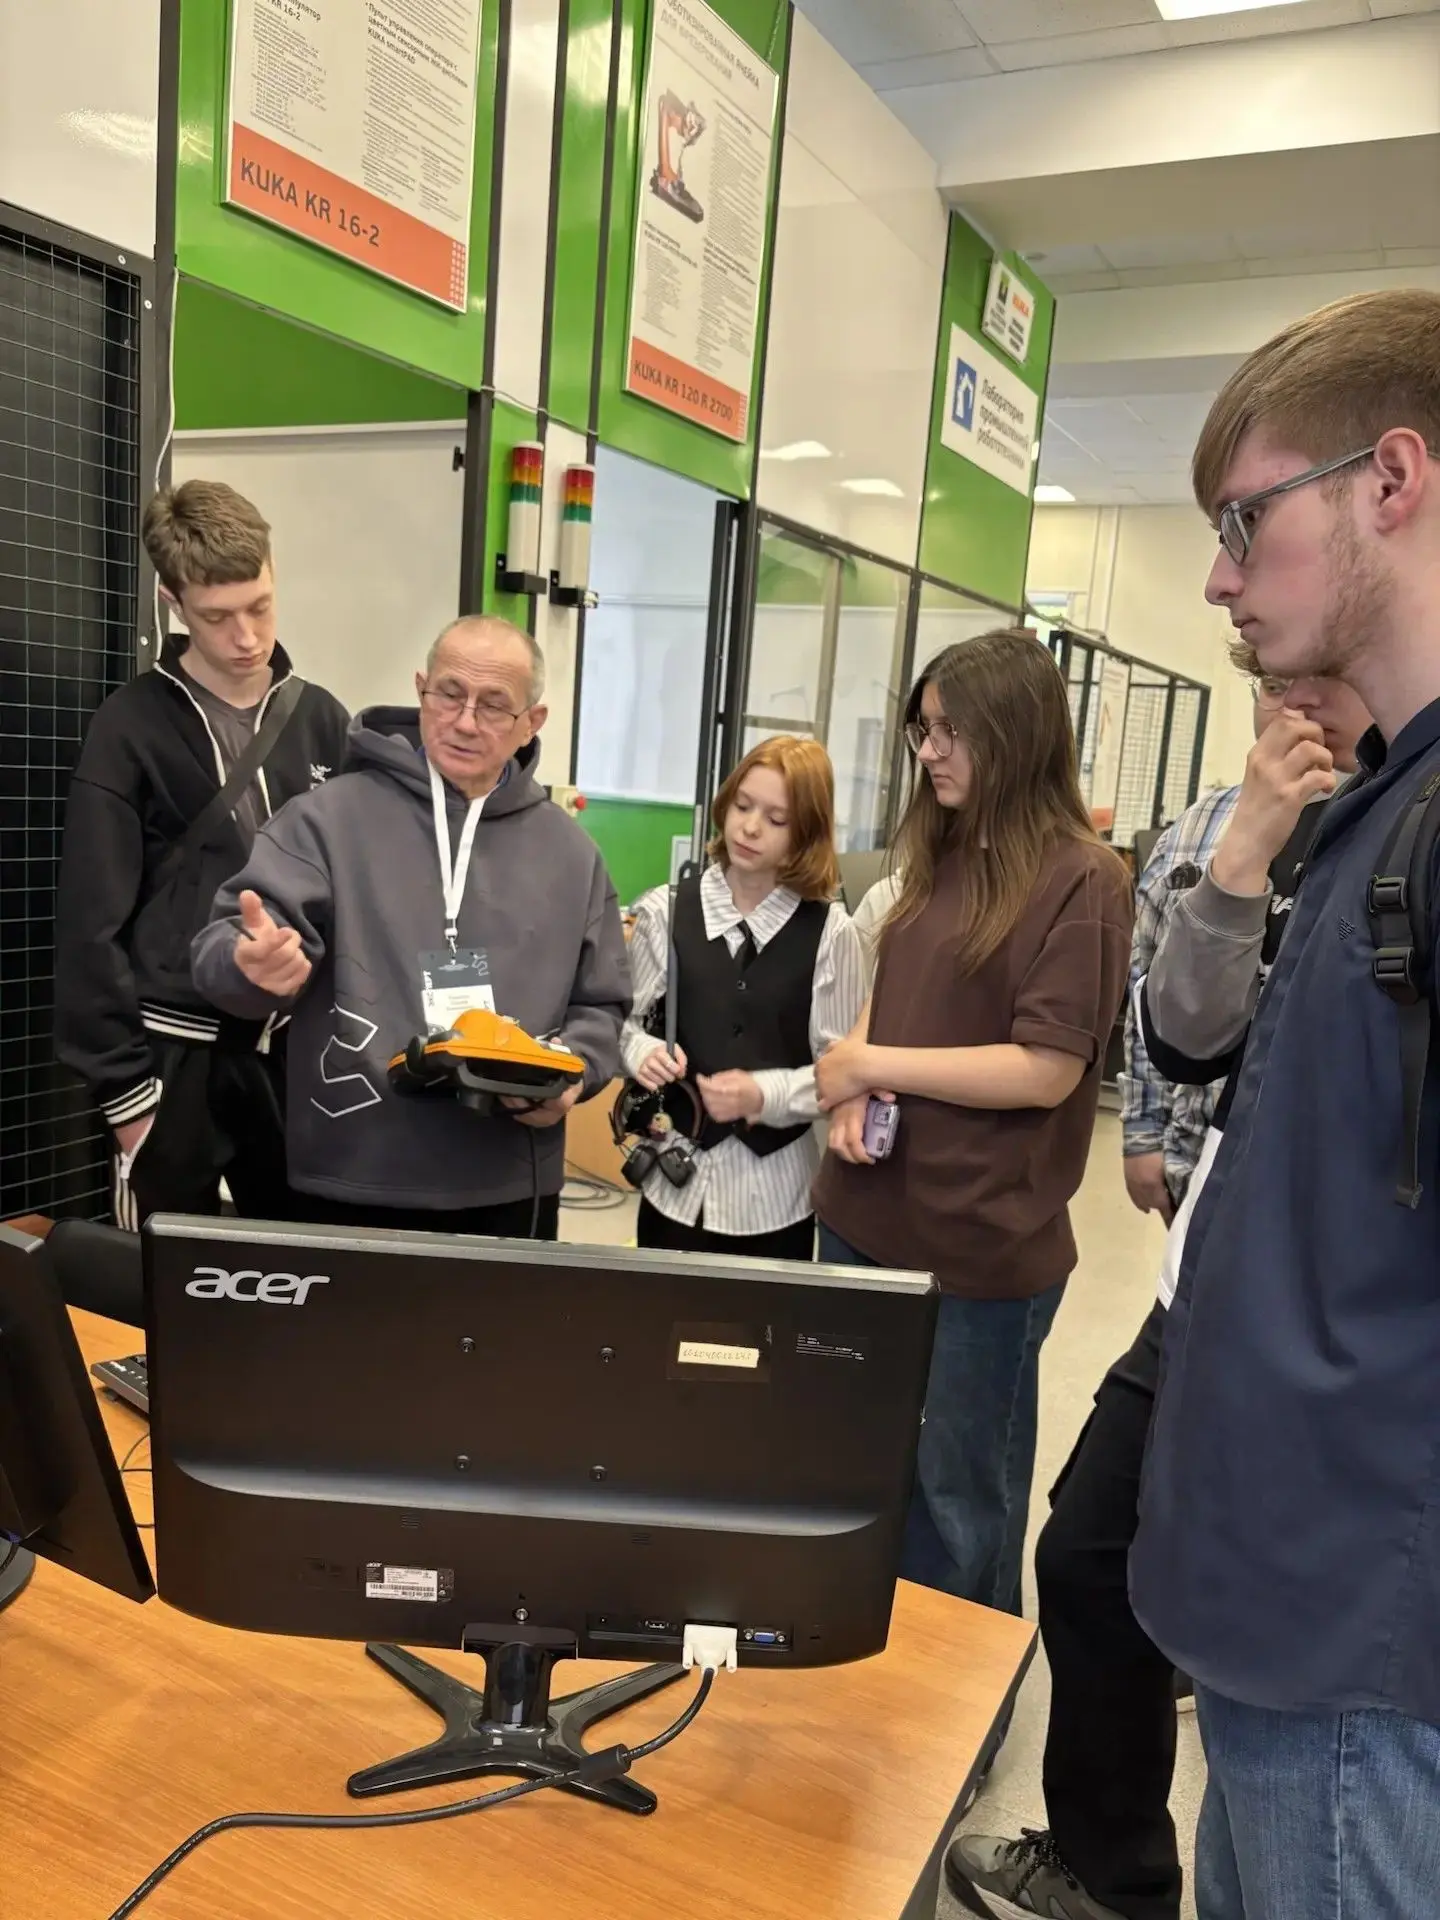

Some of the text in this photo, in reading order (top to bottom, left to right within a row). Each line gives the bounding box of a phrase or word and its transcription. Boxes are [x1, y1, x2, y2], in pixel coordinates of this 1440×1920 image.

[284, 4, 300, 21] 16-2
[368, 27, 386, 45] KUKA
[240, 157, 380, 247] KUKA KR 16-2
[633, 360, 662, 388] KUKA
[664, 374, 679, 396] KR
[681, 383, 700, 406] 120
[709, 398, 733, 421] 2700
[981, 378, 1024, 425] Лаборатория
[184, 1266, 331, 1306] acer
